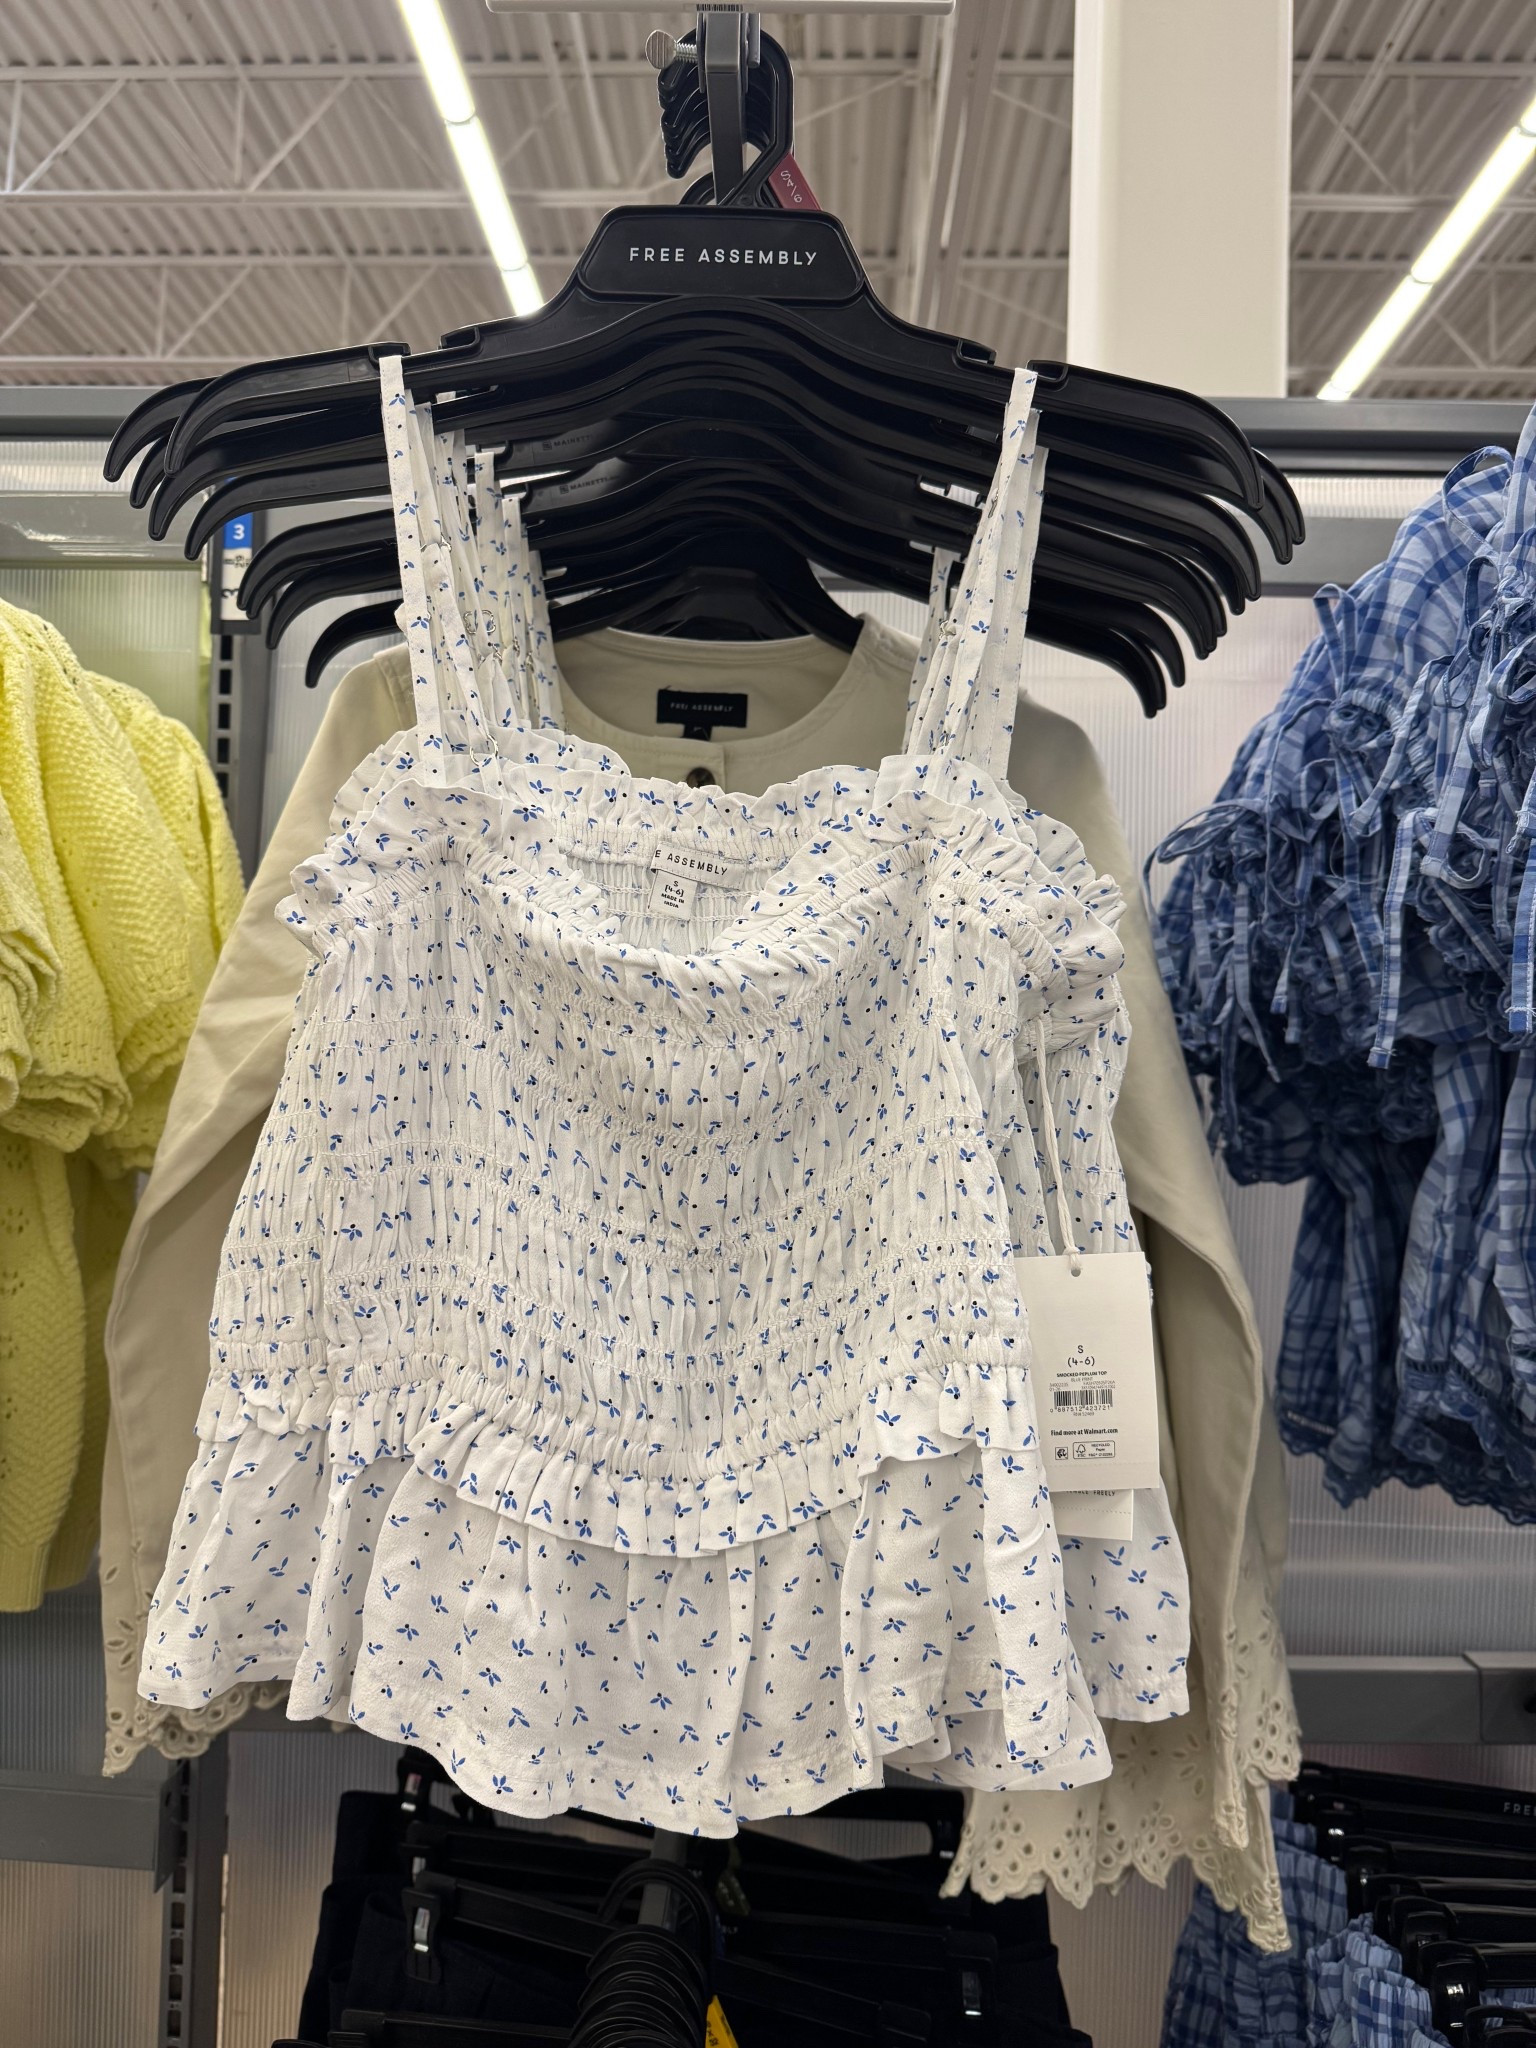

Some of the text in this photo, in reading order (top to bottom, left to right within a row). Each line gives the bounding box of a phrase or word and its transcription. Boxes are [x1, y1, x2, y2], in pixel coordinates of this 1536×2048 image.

[629, 247, 817, 266] FREE ASSEMBLY
[232, 523, 245, 540] 3
[667, 853, 728, 876] ASSEMBLY
[661, 892, 677, 902] MADE
[663, 900, 679, 909] INDIA
[1077, 1344, 1084, 1354] S
[1067, 1355, 1096, 1368] (4-6)
